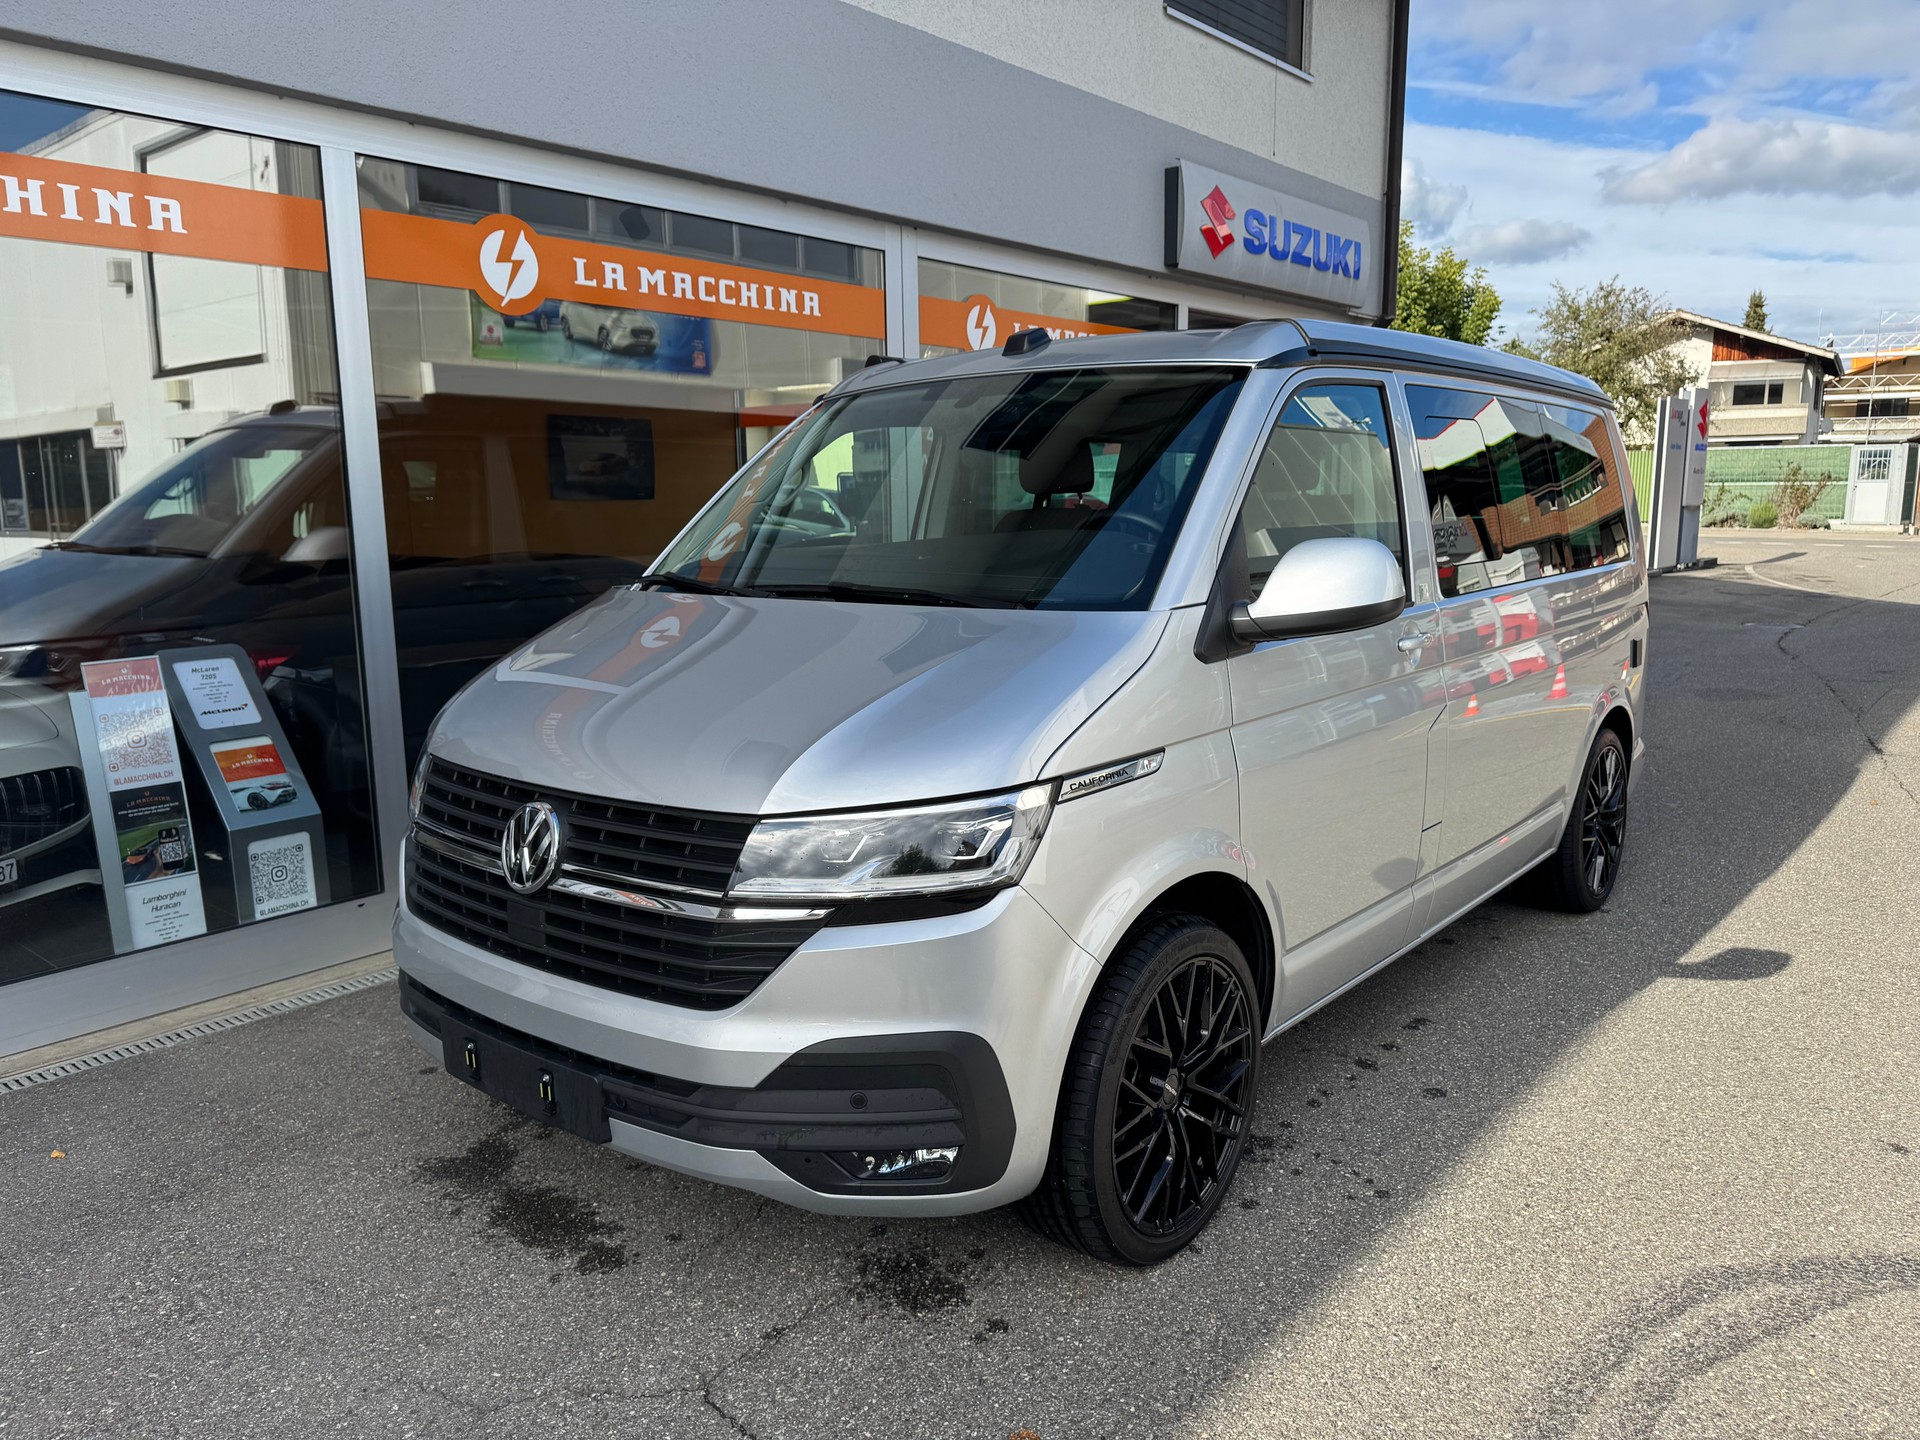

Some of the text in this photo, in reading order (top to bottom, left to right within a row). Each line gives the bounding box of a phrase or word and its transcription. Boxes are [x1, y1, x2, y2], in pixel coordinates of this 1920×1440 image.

[1243, 208, 1361, 280] SUZUKI
[573, 257, 821, 317] LA MACCHINA
[191, 666, 220, 674] McLaren
[200, 705, 247, 716] McLaren
[114, 770, 174, 786] @LAMACCHINA.CH
[1069, 768, 1129, 791] CALIFORNIA
[142, 888, 188, 905] Lamborghini
[151, 901, 182, 913] Huracan
